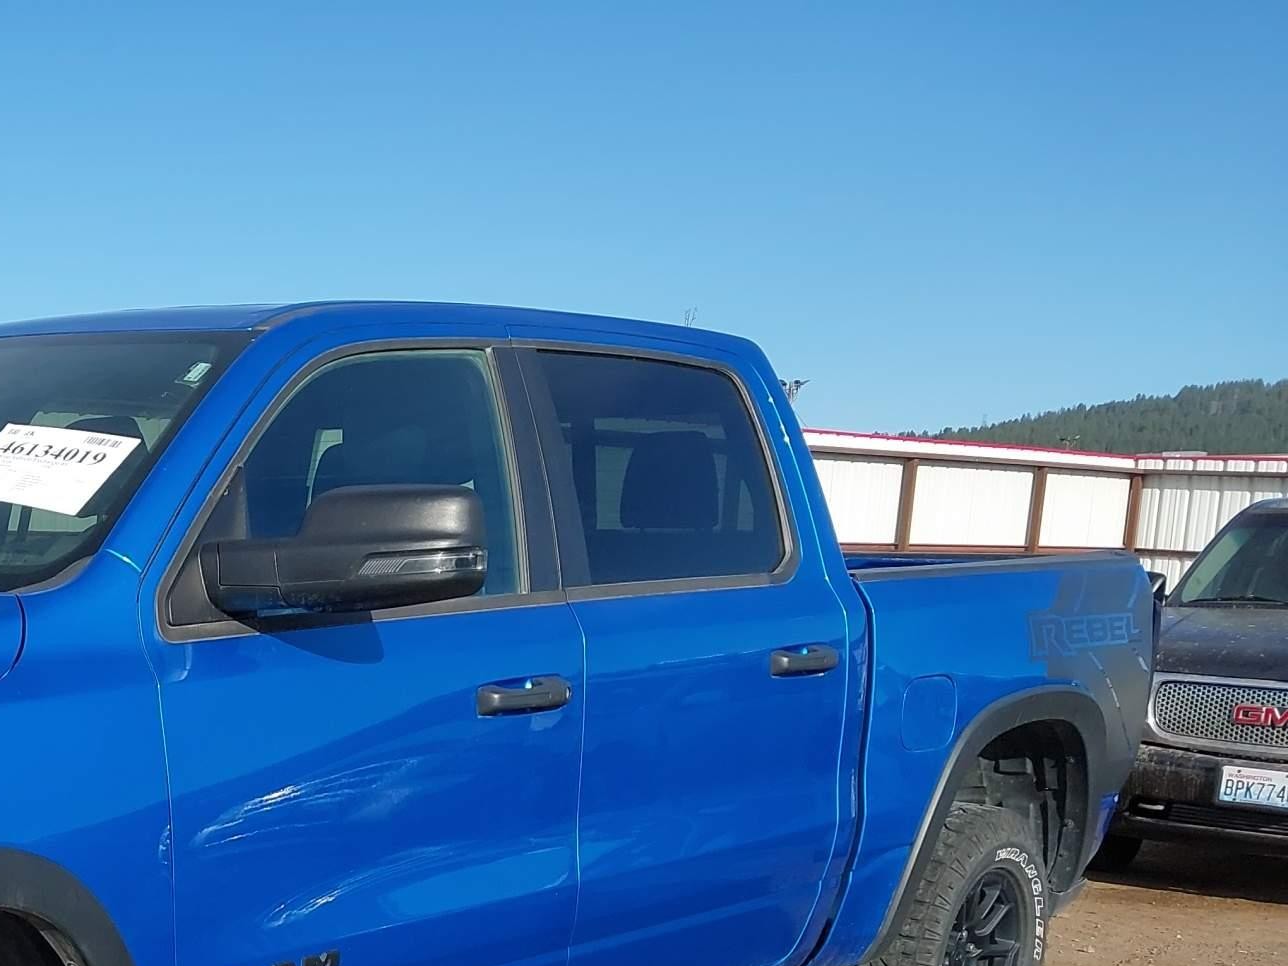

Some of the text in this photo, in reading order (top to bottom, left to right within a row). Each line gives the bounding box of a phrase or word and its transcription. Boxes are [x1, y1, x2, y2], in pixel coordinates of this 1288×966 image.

[0, 440, 108, 465] 46134019
[1027, 611, 1142, 657] REBEL
[1233, 704, 1288, 727] GM
[1228, 772, 1273, 783] WASHINGTON
[1223, 778, 1288, 804] BPK774
[995, 847, 1044, 961] WRANGLER
